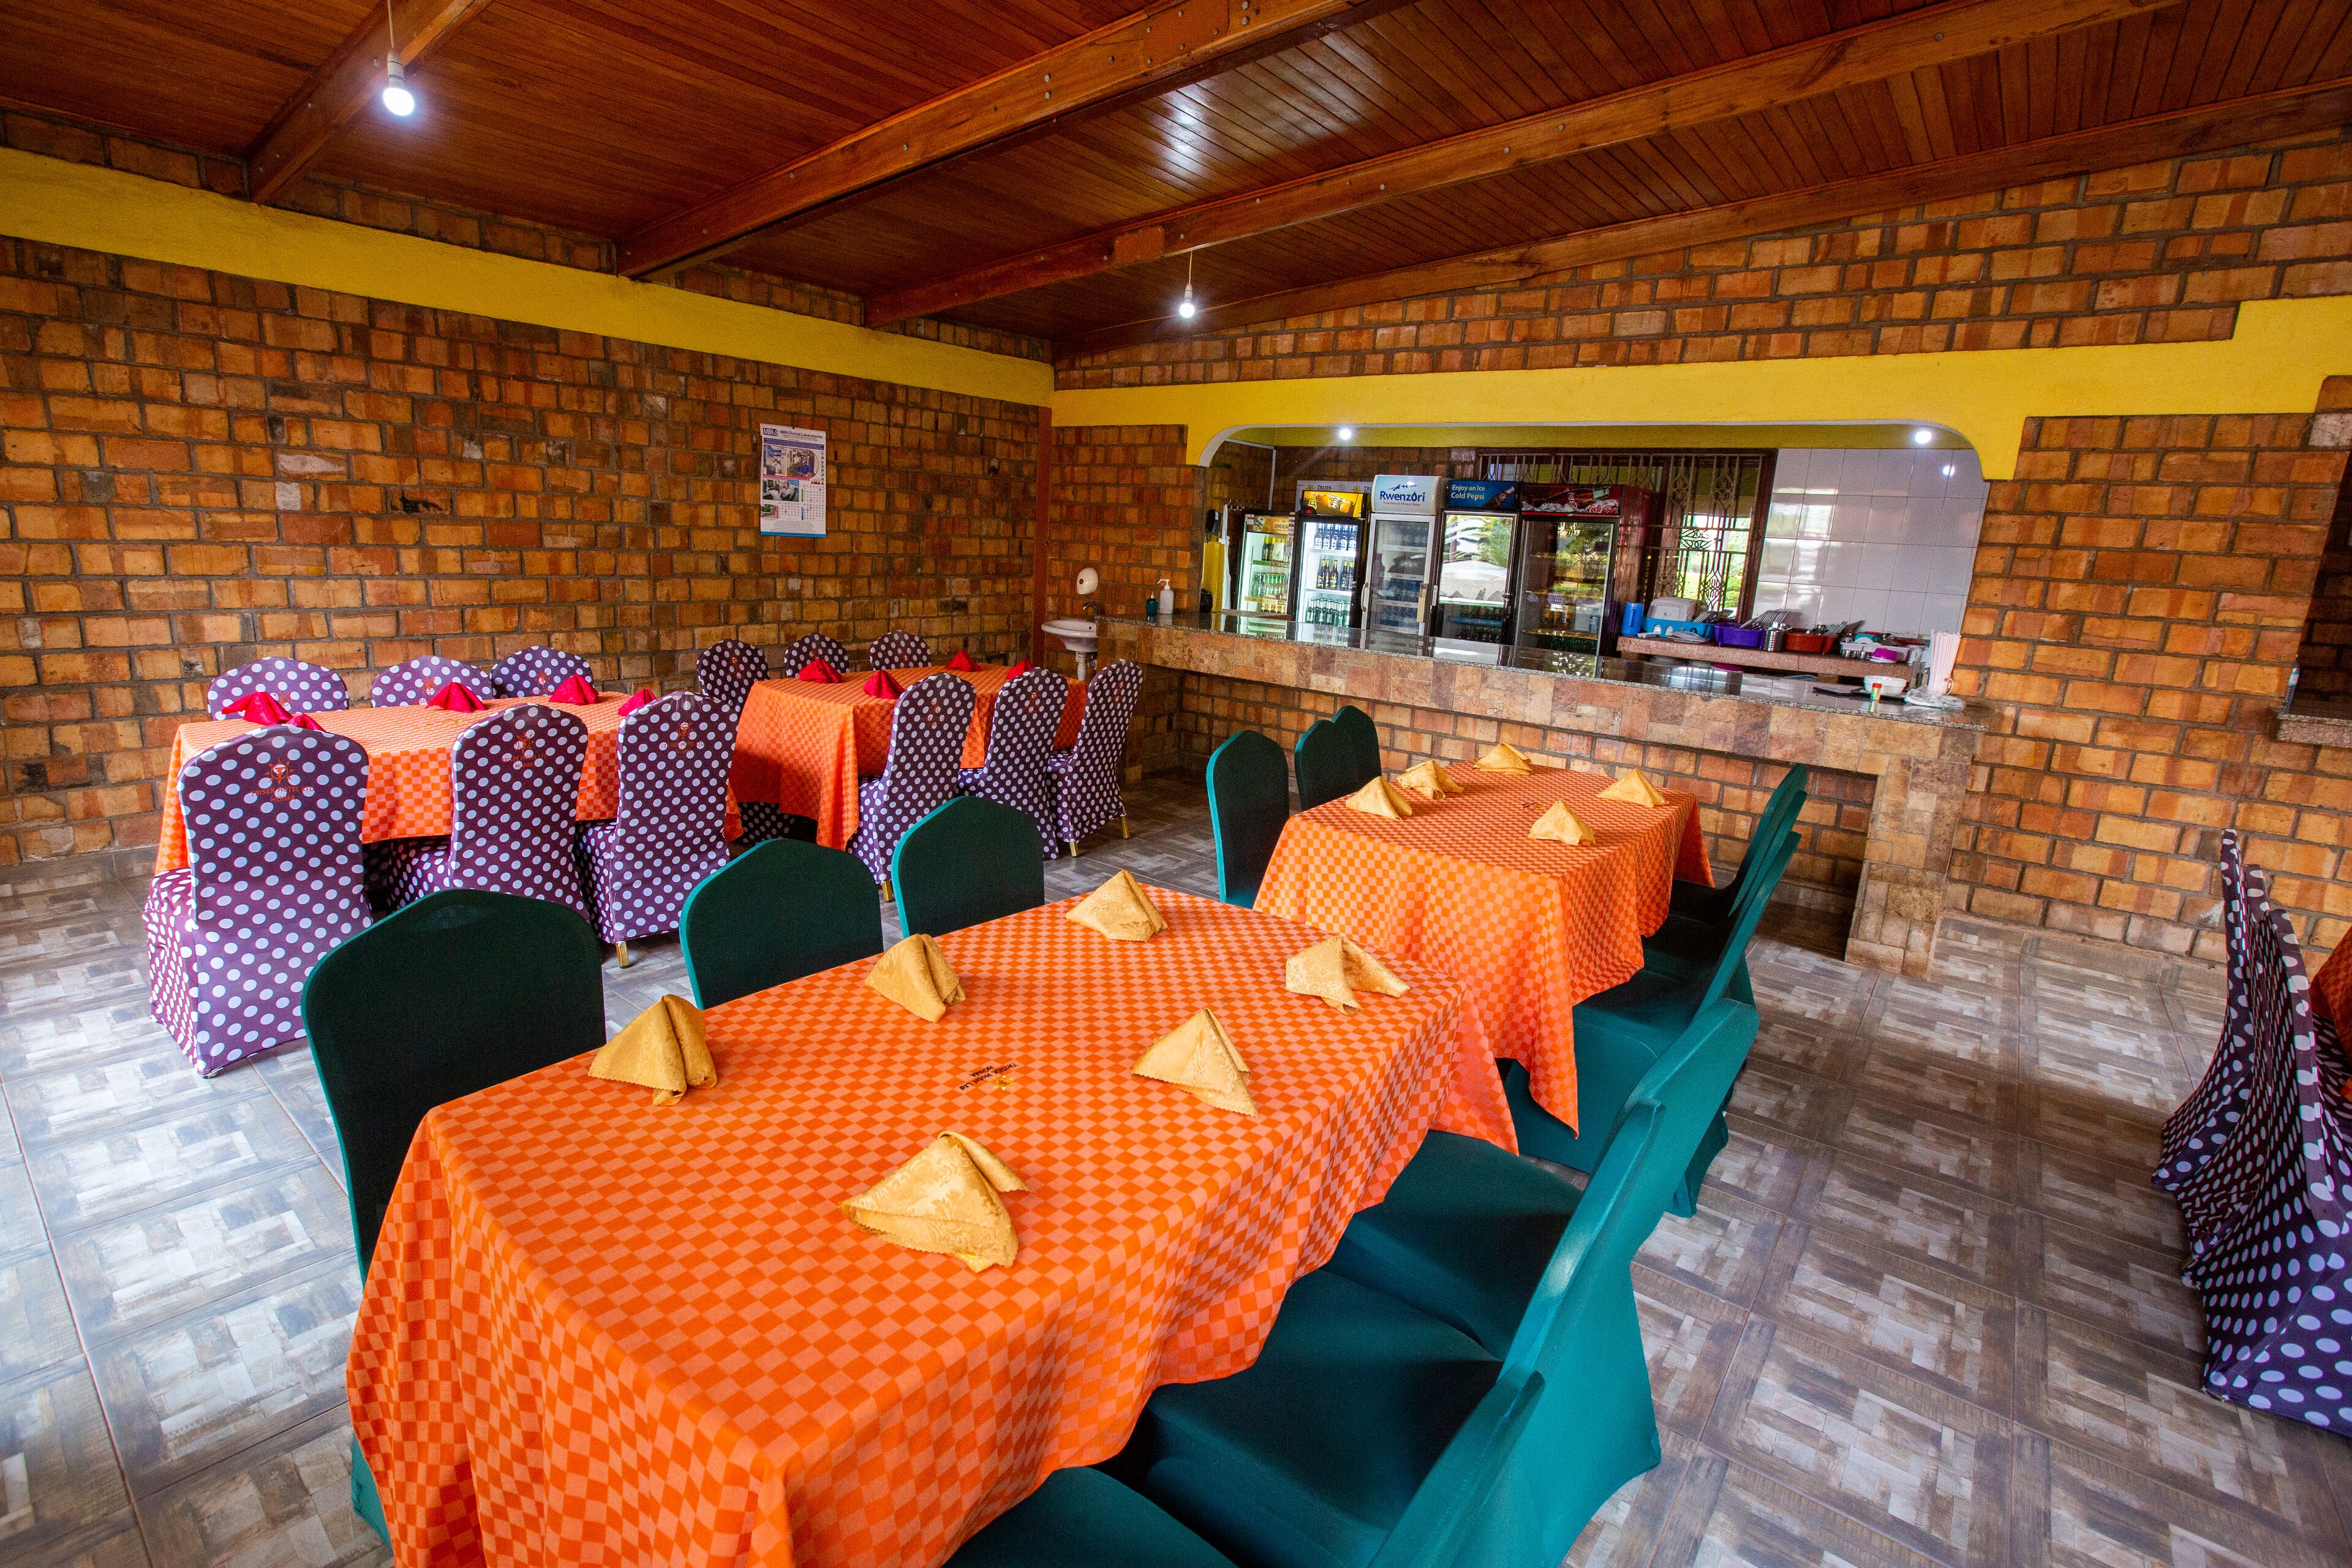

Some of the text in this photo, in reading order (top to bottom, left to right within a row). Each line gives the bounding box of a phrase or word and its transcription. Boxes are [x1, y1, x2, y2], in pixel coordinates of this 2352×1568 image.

[1379, 491, 1425, 502] Rwenzori
[251, 788, 275, 796] TRISEK
[972, 1073, 992, 1084] Hotel
